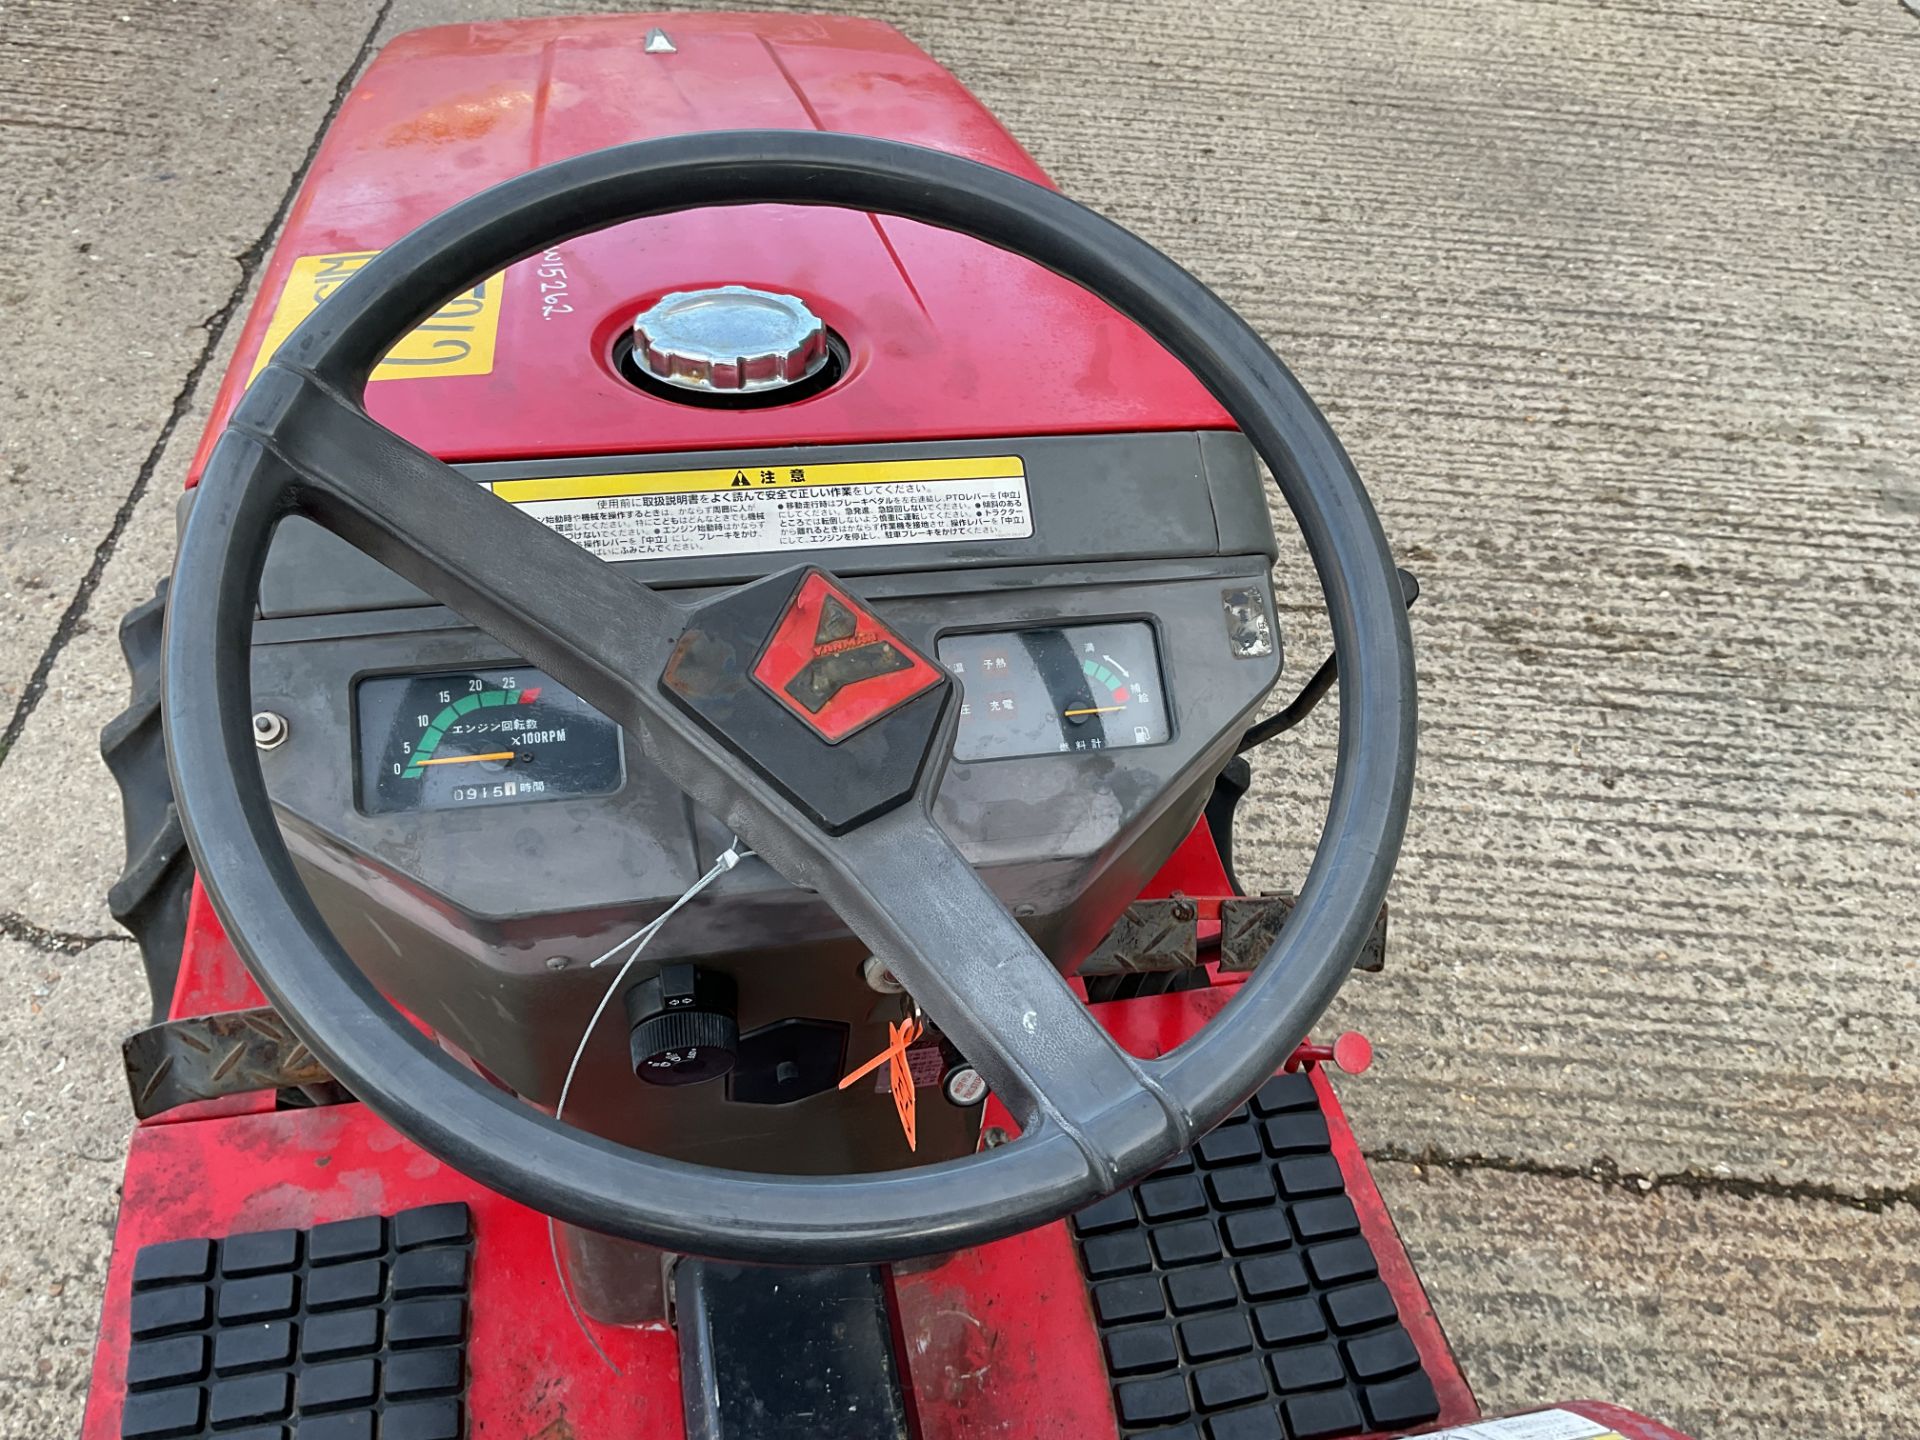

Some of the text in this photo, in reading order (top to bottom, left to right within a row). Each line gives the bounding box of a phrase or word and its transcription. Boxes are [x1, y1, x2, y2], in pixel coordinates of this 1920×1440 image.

[469, 680, 482, 691] 20
[502, 677, 515, 689] 25
[439, 691, 450, 703] 15
[418, 715, 429, 727] 10
[452, 719, 538, 734] エンジン回転数
[403, 742, 410, 754] 5
[394, 763, 400, 775] 0
[520, 781, 545, 793] 時間
